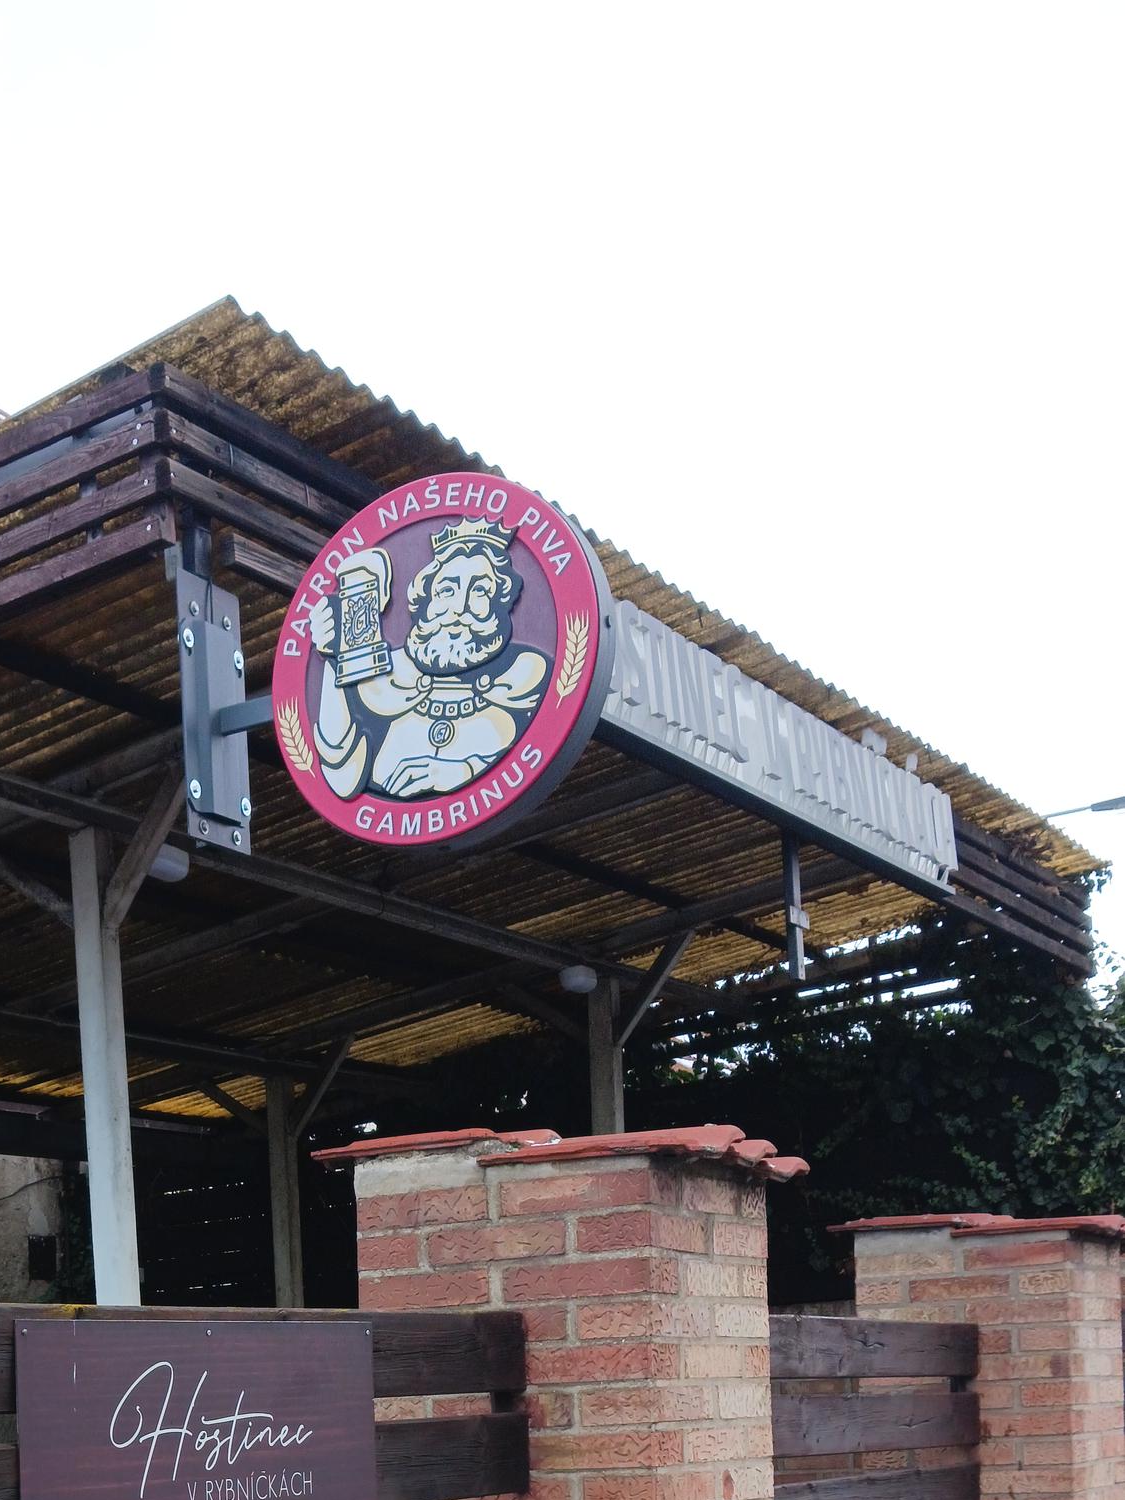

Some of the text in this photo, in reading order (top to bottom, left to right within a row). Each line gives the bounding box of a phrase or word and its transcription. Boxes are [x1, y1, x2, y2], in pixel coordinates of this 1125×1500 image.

[282, 478, 574, 657] PATRON NAŠEHO PIVA
[611, 599, 750, 763] STINEC
[354, 743, 544, 837] GAMBRINUS
[109, 1361, 313, 1499] Hostinec
